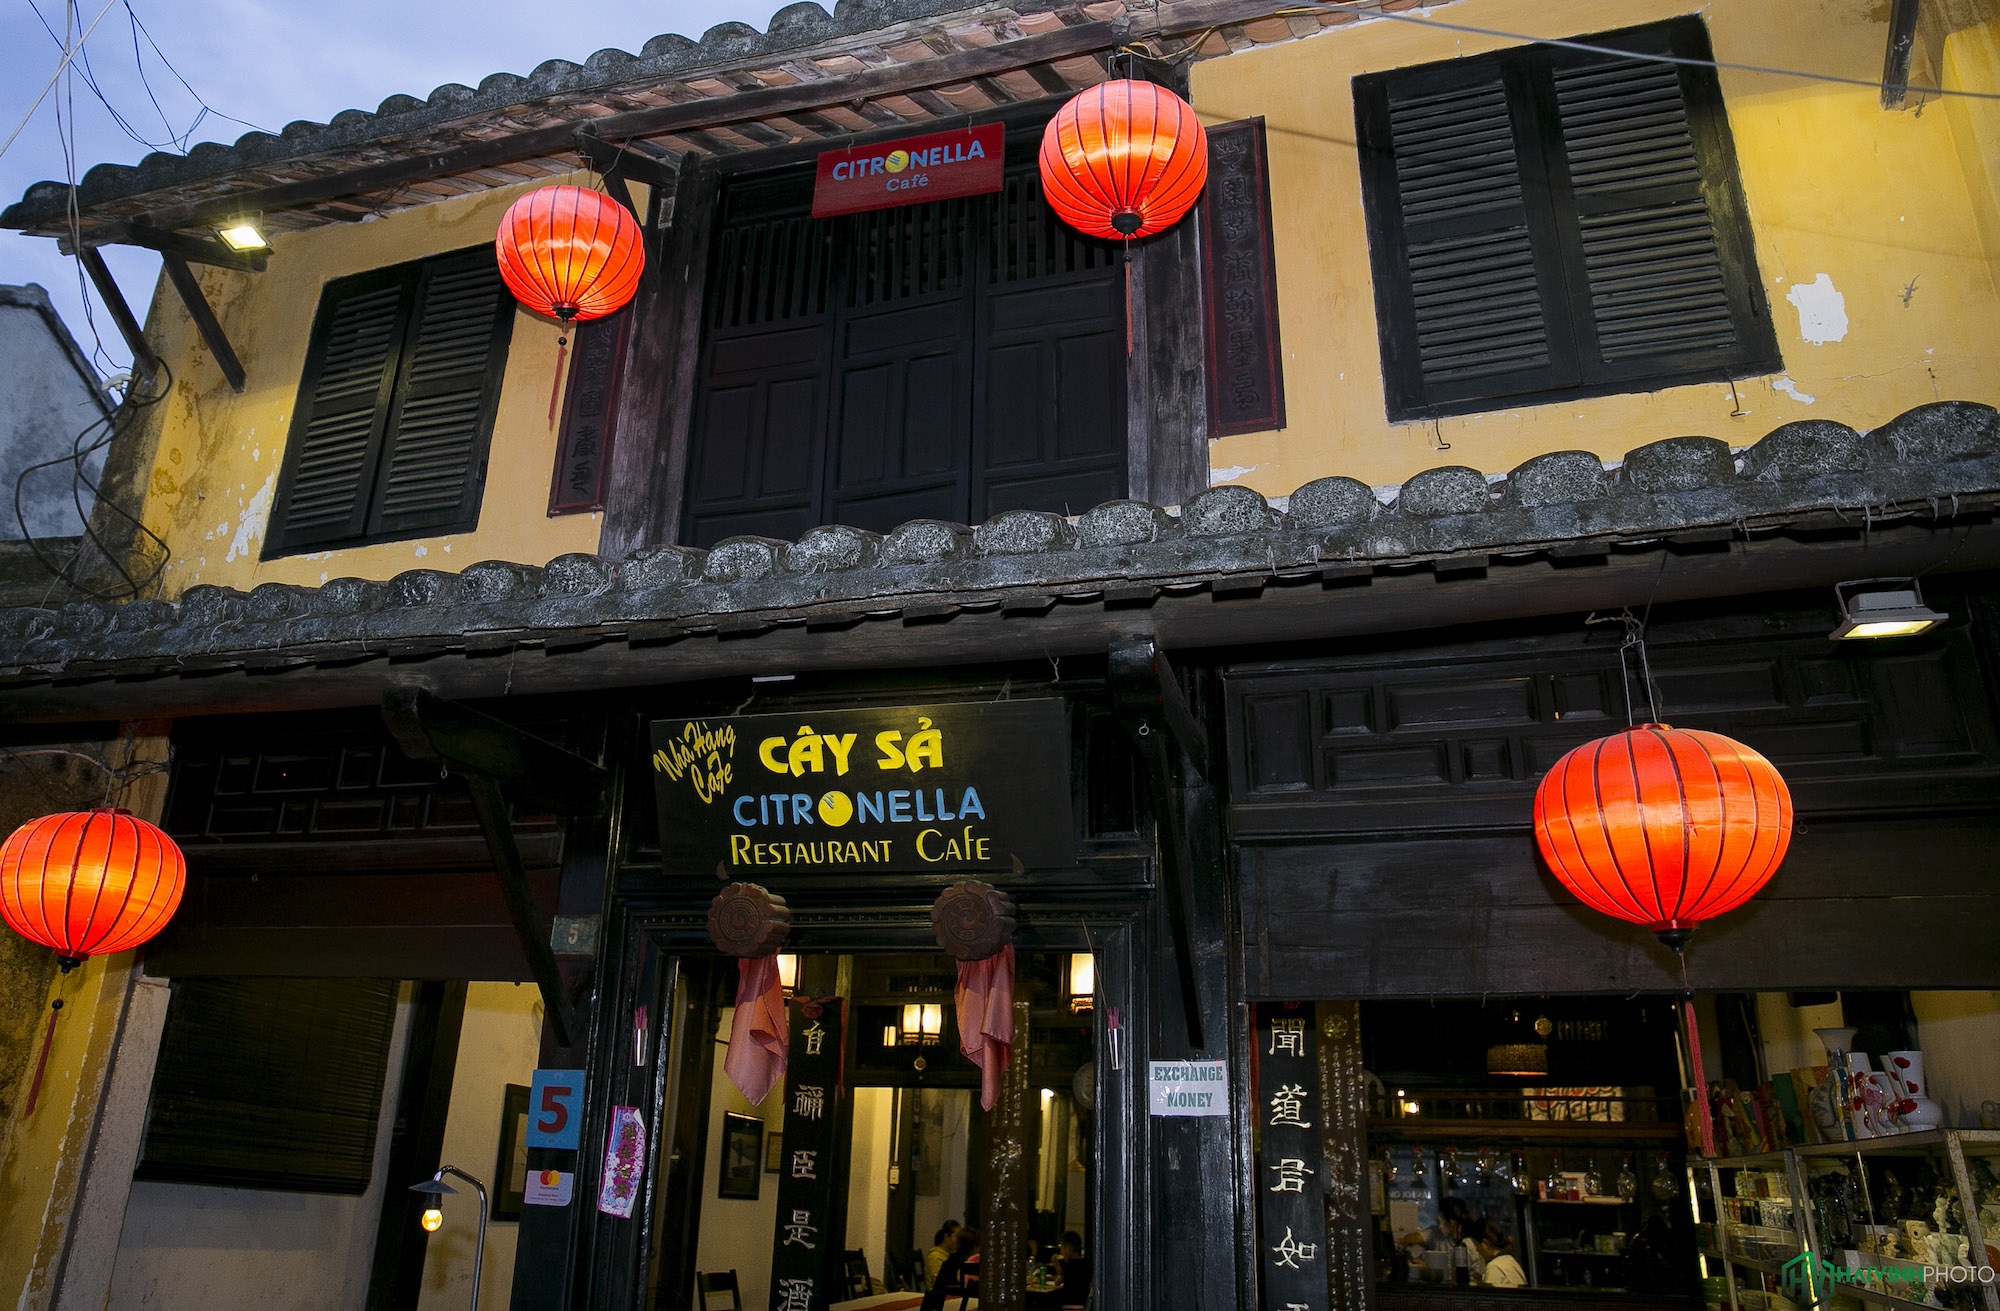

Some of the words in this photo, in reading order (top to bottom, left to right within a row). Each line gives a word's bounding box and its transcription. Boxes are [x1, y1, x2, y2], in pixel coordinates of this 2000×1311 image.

[832, 140, 985, 181] CITRONELLA
[886, 173, 929, 192] Café
[653, 736, 695, 781] Nhà
[683, 721, 736, 758] Hàng
[758, 725, 858, 778] CÂY
[874, 716, 944, 773] SẢ
[733, 786, 986, 828] CITRONELLA
[1154, 1066, 1223, 1082] EXCHANGE
[537, 1086, 572, 1134] 5
[1167, 1092, 1213, 1108] MONEY
